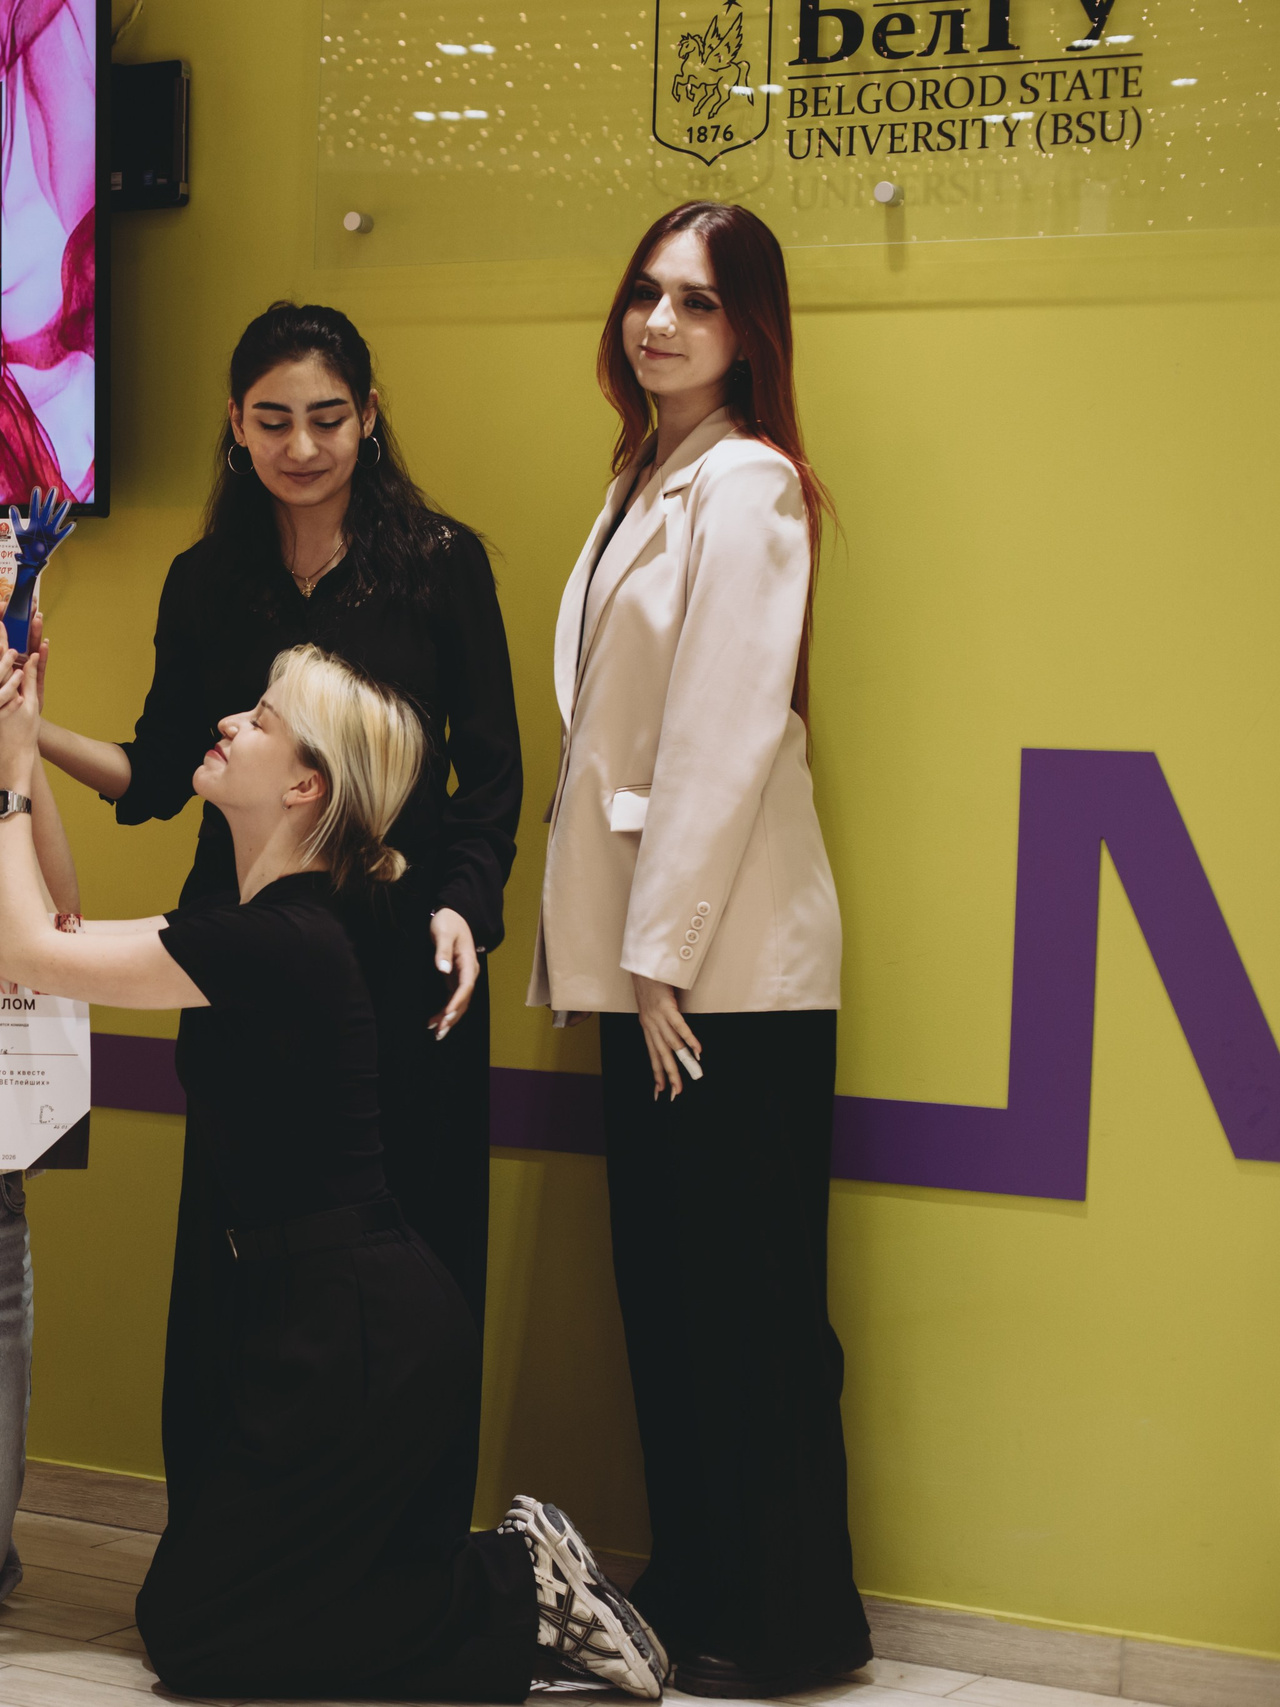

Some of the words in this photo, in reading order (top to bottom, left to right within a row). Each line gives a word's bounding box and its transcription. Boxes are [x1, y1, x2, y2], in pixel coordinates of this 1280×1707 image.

[787, 75, 1007, 119] BELGOROD
[1019, 65, 1144, 104] STATE
[686, 124, 734, 144] 1876
[787, 117, 1022, 160] UNIVERSITY
[1035, 106, 1144, 153] (BSU)
